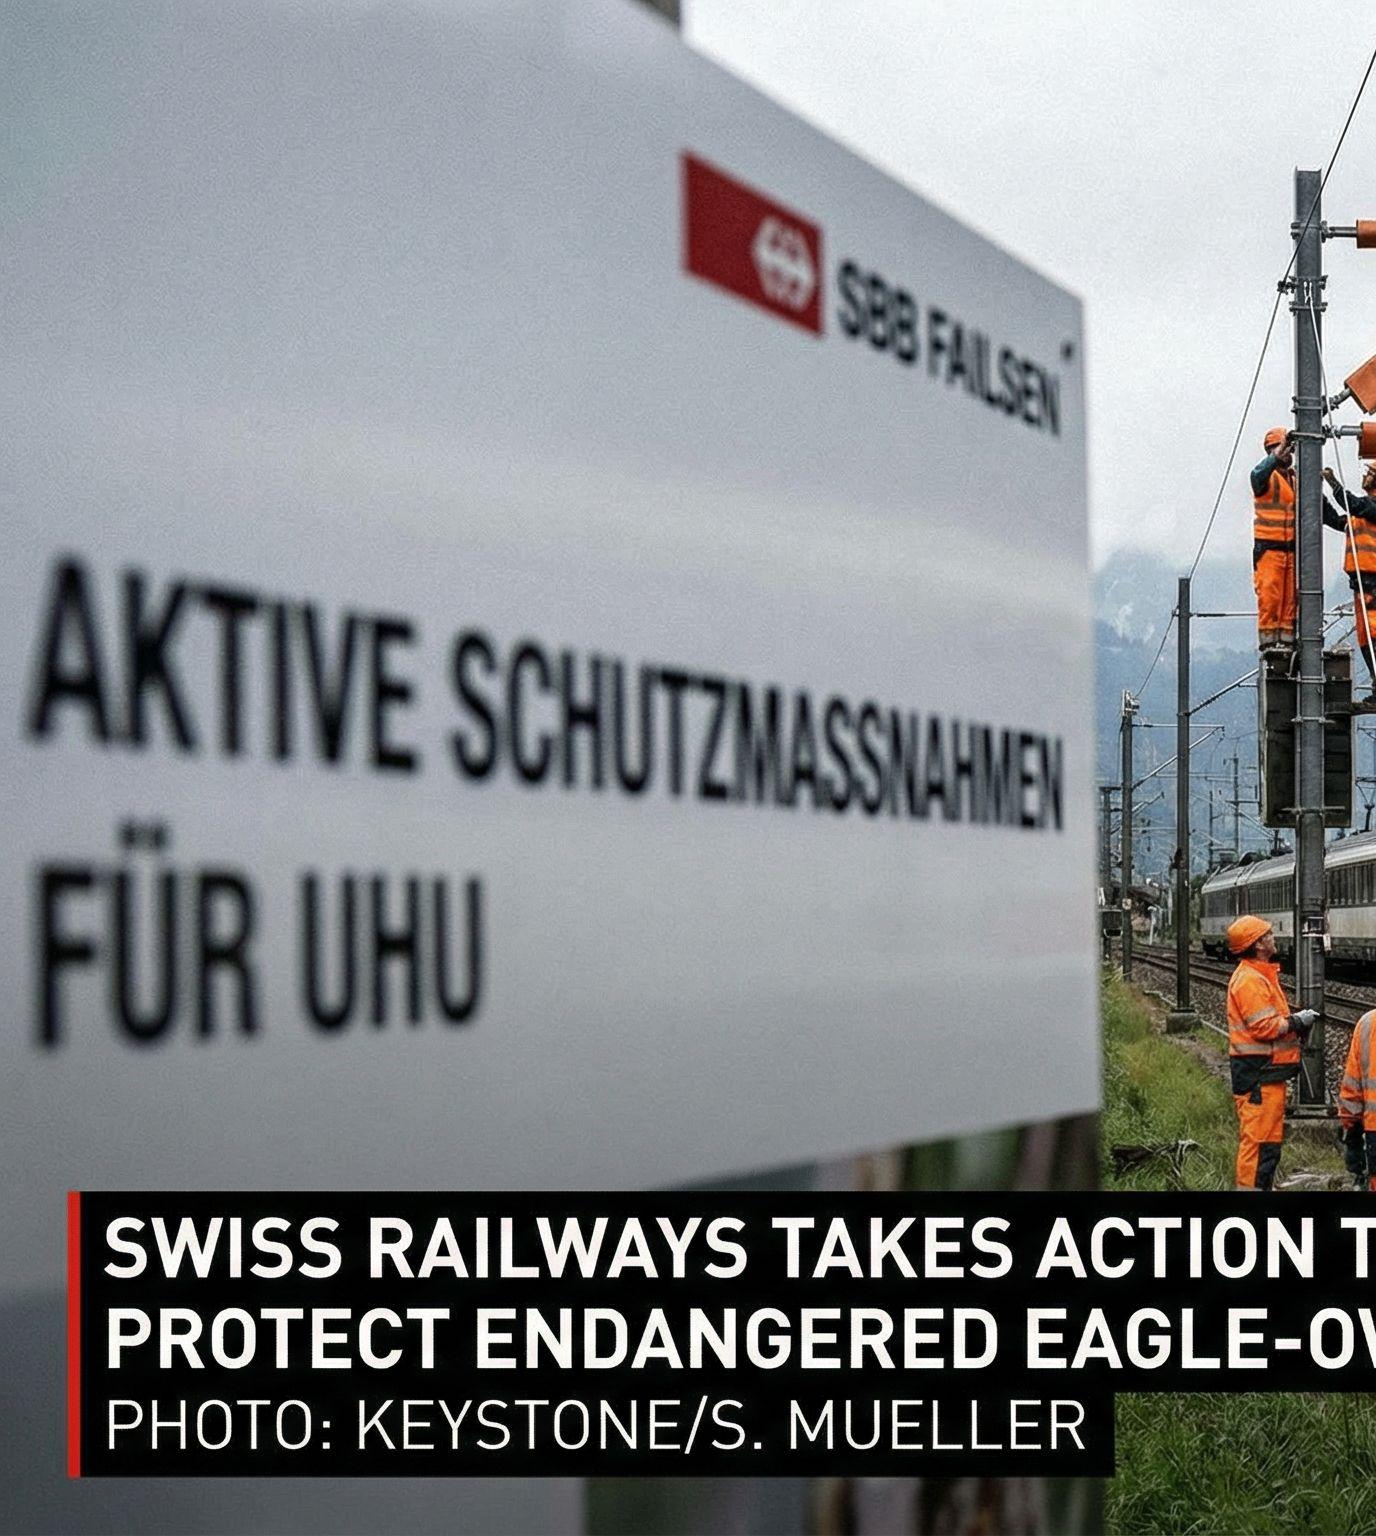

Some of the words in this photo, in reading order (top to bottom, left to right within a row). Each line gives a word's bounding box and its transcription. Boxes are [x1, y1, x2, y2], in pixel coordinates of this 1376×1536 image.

[838, 259, 919, 366] SBB
[27, 557, 418, 775] AKTIVE
[452, 632, 1062, 829] SCHUTZMASSNAHMEN
[32, 822, 262, 1055] FÜR
[301, 873, 483, 1037] UHU
